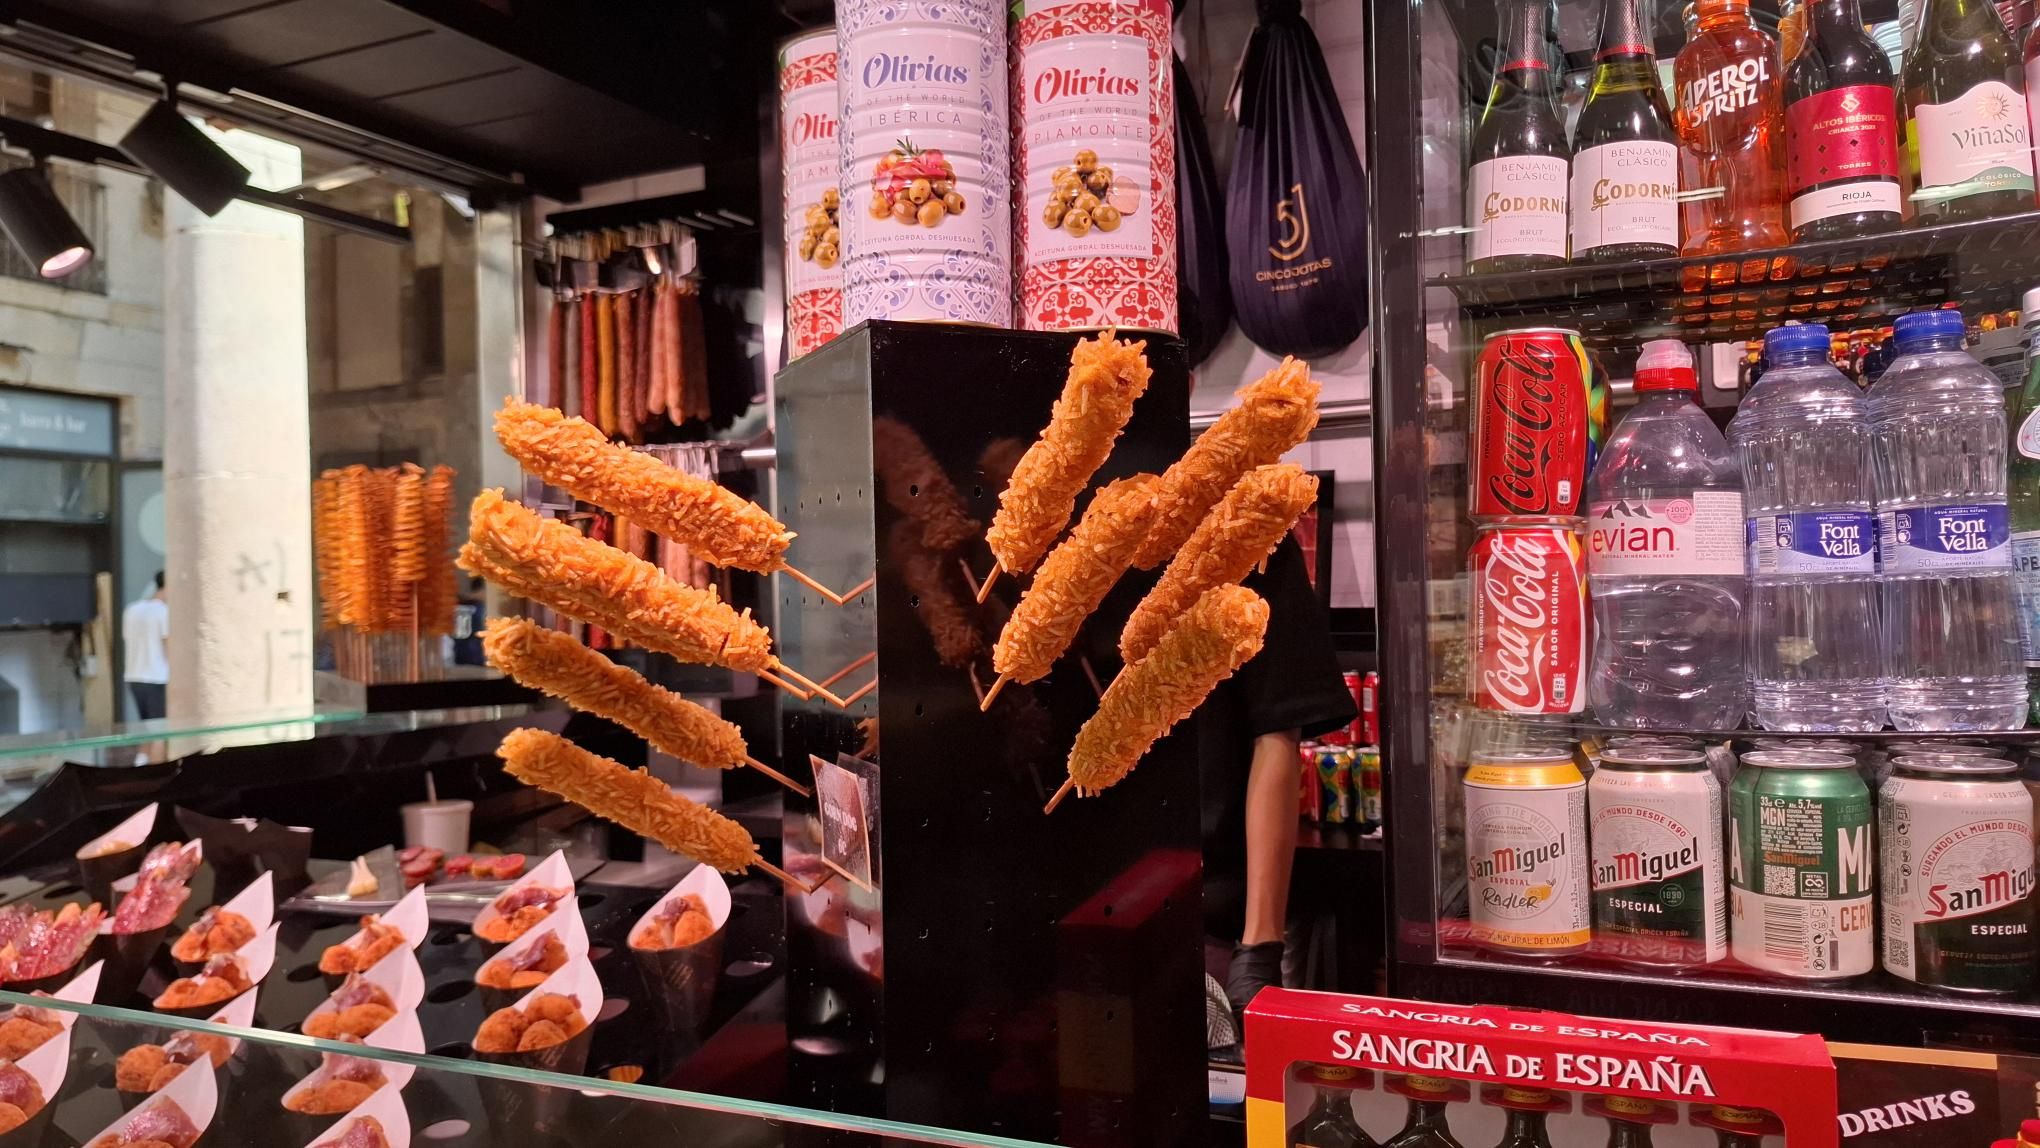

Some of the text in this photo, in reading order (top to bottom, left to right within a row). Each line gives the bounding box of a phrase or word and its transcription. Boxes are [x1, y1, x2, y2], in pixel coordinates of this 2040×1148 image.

[863, 52, 968, 88] Olivias
[1034, 67, 1139, 104] Olivias
[1684, 56, 1770, 112] APEROL
[888, 94, 910, 103] THE
[921, 94, 965, 104] WORLD
[870, 109, 961, 127] IBÉRICA
[1040, 106, 1138, 121] OF THE WORLD
[1034, 124, 1143, 144] PIAMONTE
[1812, 117, 1843, 131] ALTOS
[1952, 123, 2026, 149] ViñaSol
[1617, 157, 1667, 167] CLÁSICO
[1839, 161, 1872, 169] TORRES
[1507, 171, 1557, 181] CLÁSICO
[1842, 191, 1872, 200] RIOJA
[1256, 257, 1333, 281] CINCOJOTAS
[1820, 523, 1860, 539] Font
[1938, 518, 1987, 534] Font
[1592, 522, 1675, 552] evian
[1938, 533, 1989, 551] Vella
[1820, 539, 1861, 556] Vella
[1551, 571, 1559, 666] SABOR ORIGINAL
[1506, 806, 1527, 817] THE
[1528, 814, 1559, 844] WORLD
[1606, 807, 1633, 816] MUNDO
[1636, 809, 1666, 824] DESDE
[1666, 820, 1687, 838] 1890
[1760, 806, 1786, 827] MGN
[1469, 832, 1566, 882] SanMiguel
[1921, 837, 1953, 877] SURCANDO
[1956, 830, 1968, 840] EL
[1969, 822, 2004, 835] MUNDO
[1593, 837, 1699, 889] SanMiguel
[1490, 876, 1530, 887] ESPECIAL
[1609, 898, 1663, 914] ESPECIAL
[1971, 923, 2028, 935] ESPECIAL
[1546, 935, 1570, 945] LIMÓN
[1340, 1003, 1711, 1047] SANGRIA DE ESPAÑA
[1332, 1029, 1717, 1097] SANGRIA DE ESPAÑA
[1837, 1090, 1976, 1137] DRINKS
